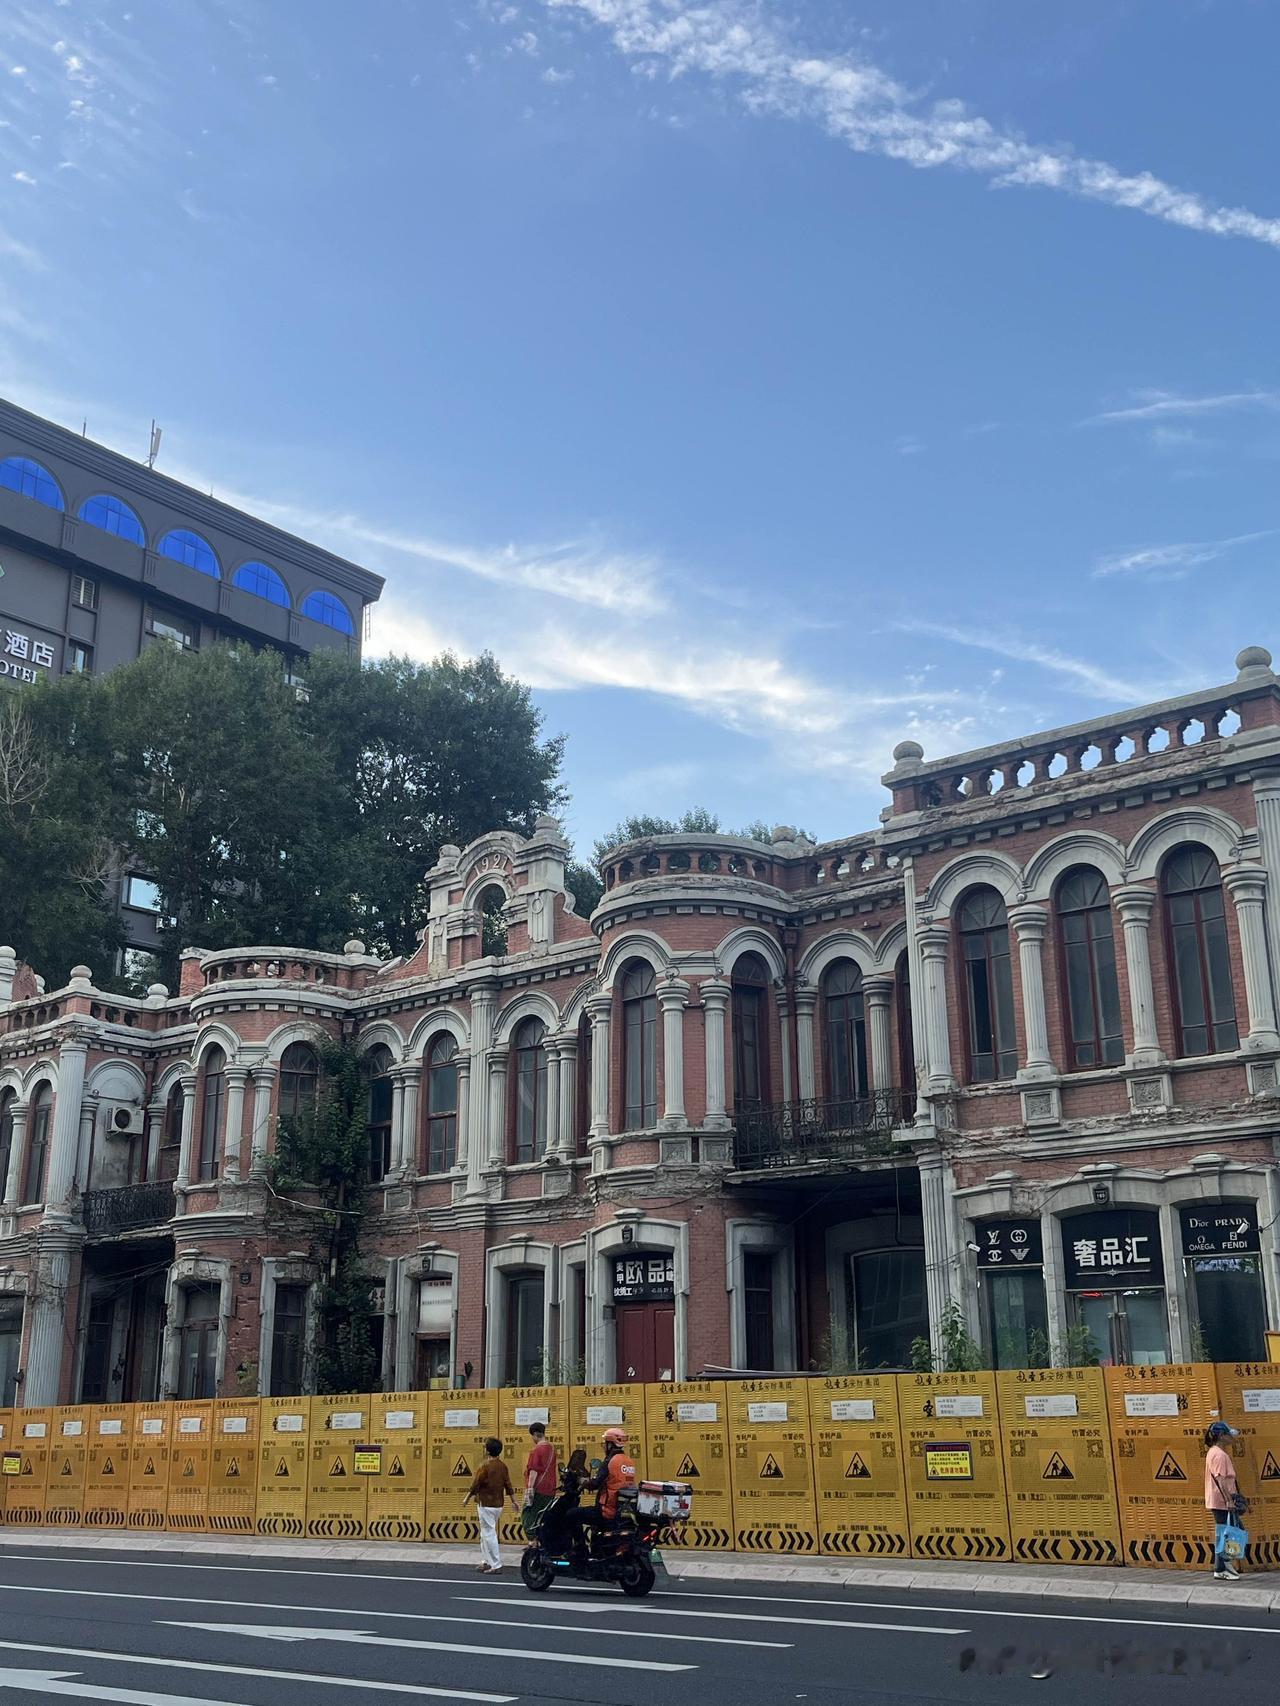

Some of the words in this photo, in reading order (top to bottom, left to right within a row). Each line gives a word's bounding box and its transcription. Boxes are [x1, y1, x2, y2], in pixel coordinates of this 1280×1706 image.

[1189, 1218, 1209, 1228] Dior
[1188, 1243, 1215, 1251] OMEGA
[1222, 1241, 1248, 1249] FENDI
[1074, 1236, 1151, 1267] 奢品汇
[625, 1260, 665, 1284] 欧品
